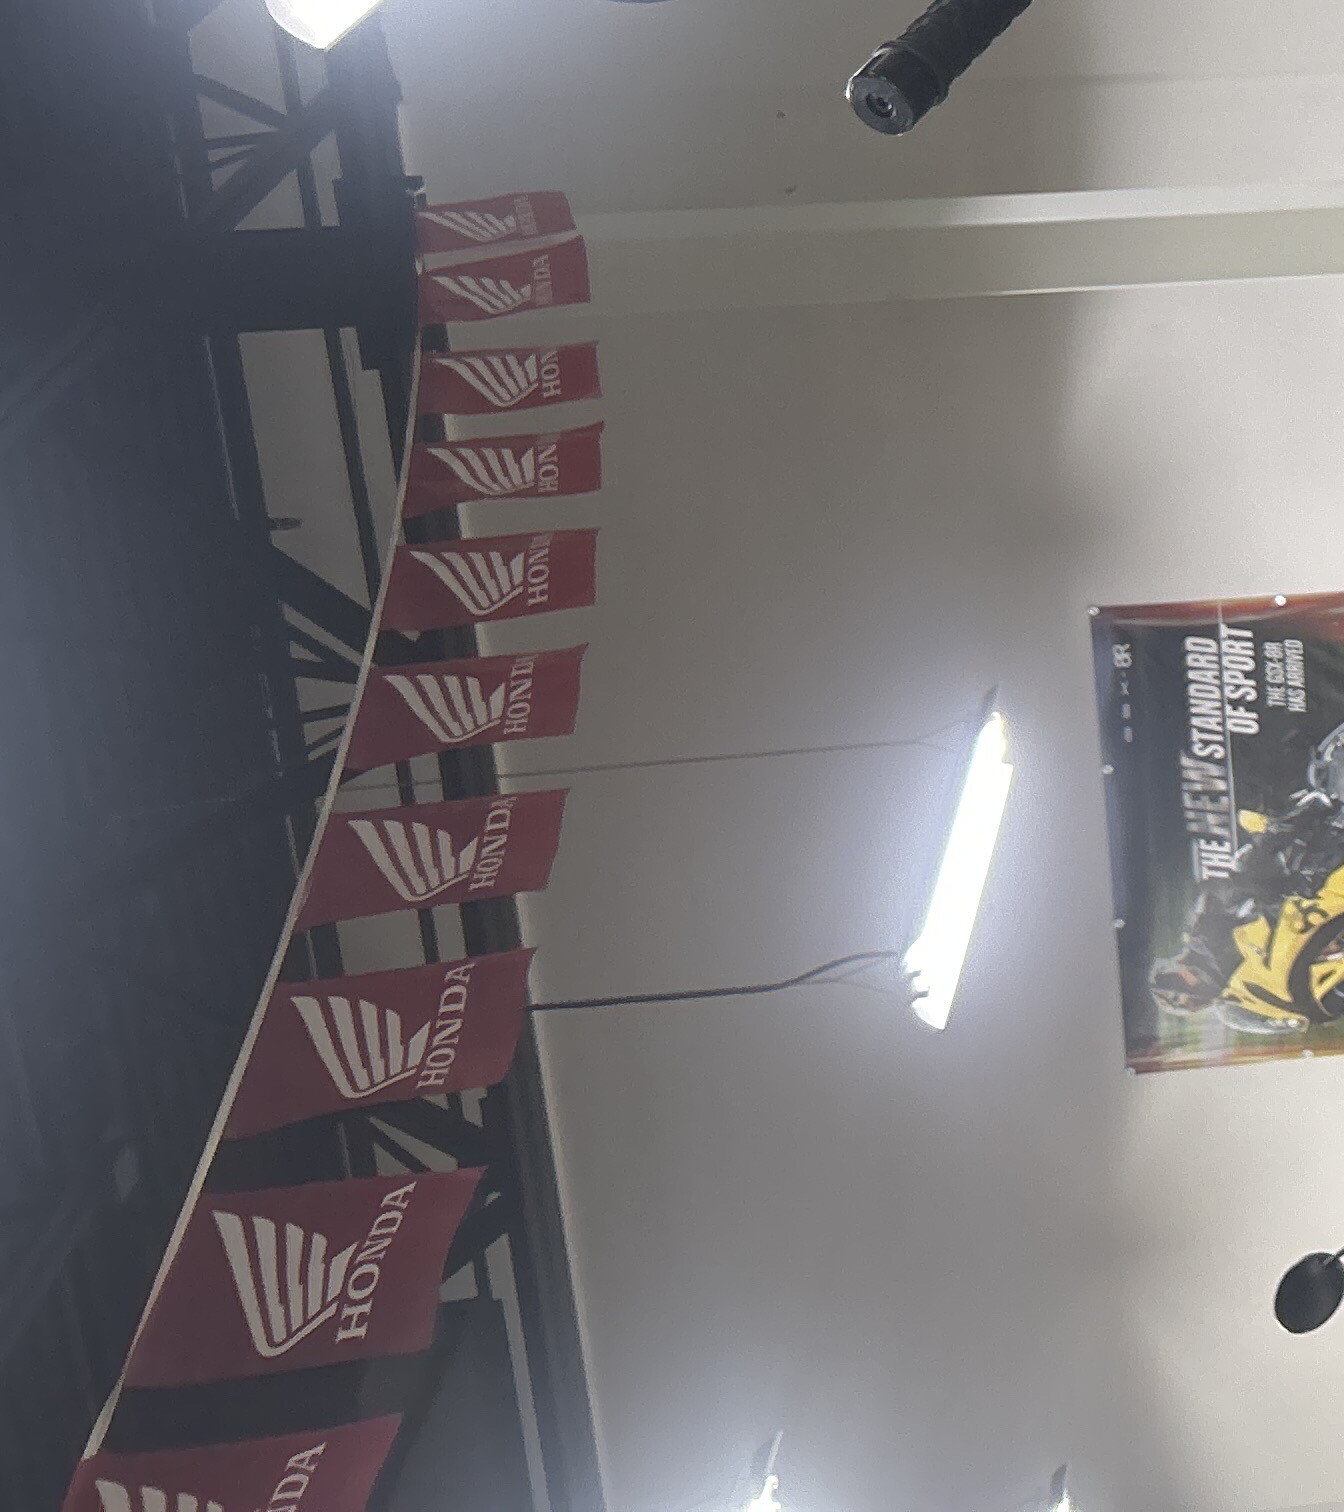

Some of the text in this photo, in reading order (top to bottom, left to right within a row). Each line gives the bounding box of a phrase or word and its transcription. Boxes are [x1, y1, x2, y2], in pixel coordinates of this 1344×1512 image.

[1220, 622, 1260, 734] OF SPORT
[1265, 684, 1286, 707] THE
[1283, 638, 1307, 712] HAS ARRIVED
[1179, 636, 1232, 880] THE NEW STANDARD
[468, 796, 517, 892] HONDA
[416, 961, 477, 1089] HONDA
[333, 1181, 417, 1345] HONDA
